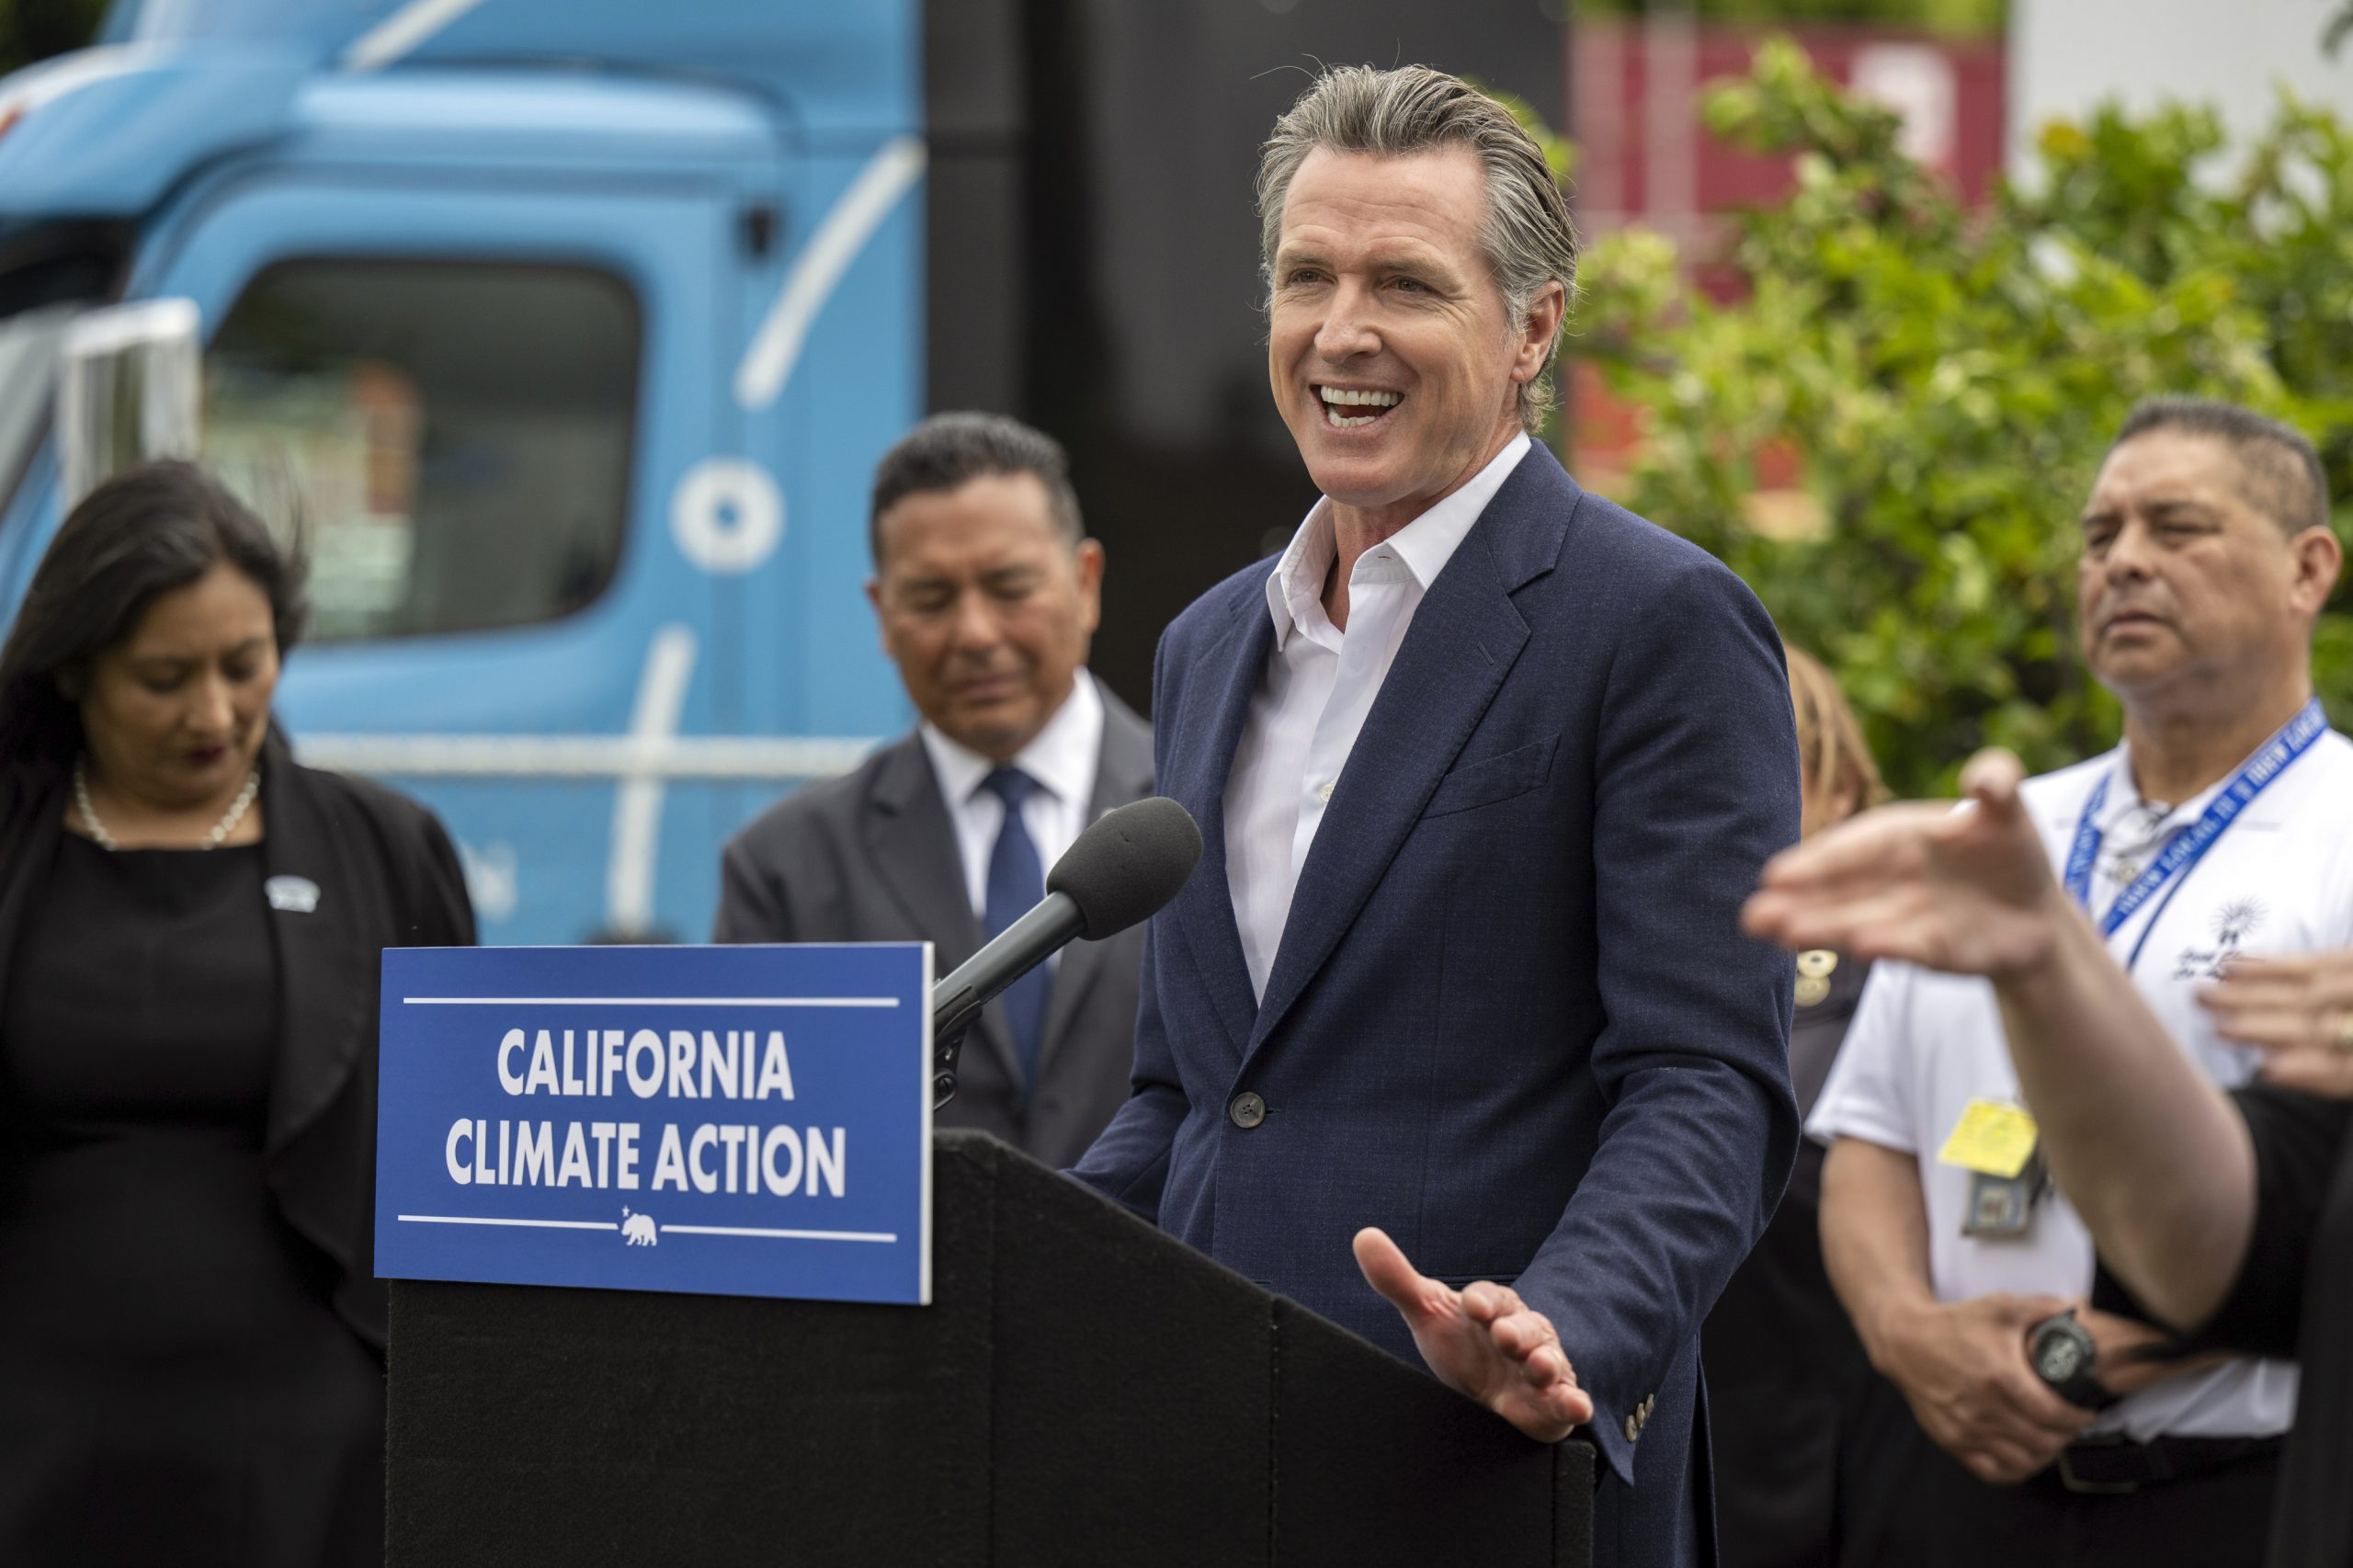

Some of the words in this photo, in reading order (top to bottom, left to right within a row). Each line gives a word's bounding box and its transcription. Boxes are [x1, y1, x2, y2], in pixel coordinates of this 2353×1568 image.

[496, 1028, 795, 1102] CALIFORNIA
[445, 1118, 641, 1190] CLIMATE
[651, 1122, 847, 1199] ACTION
